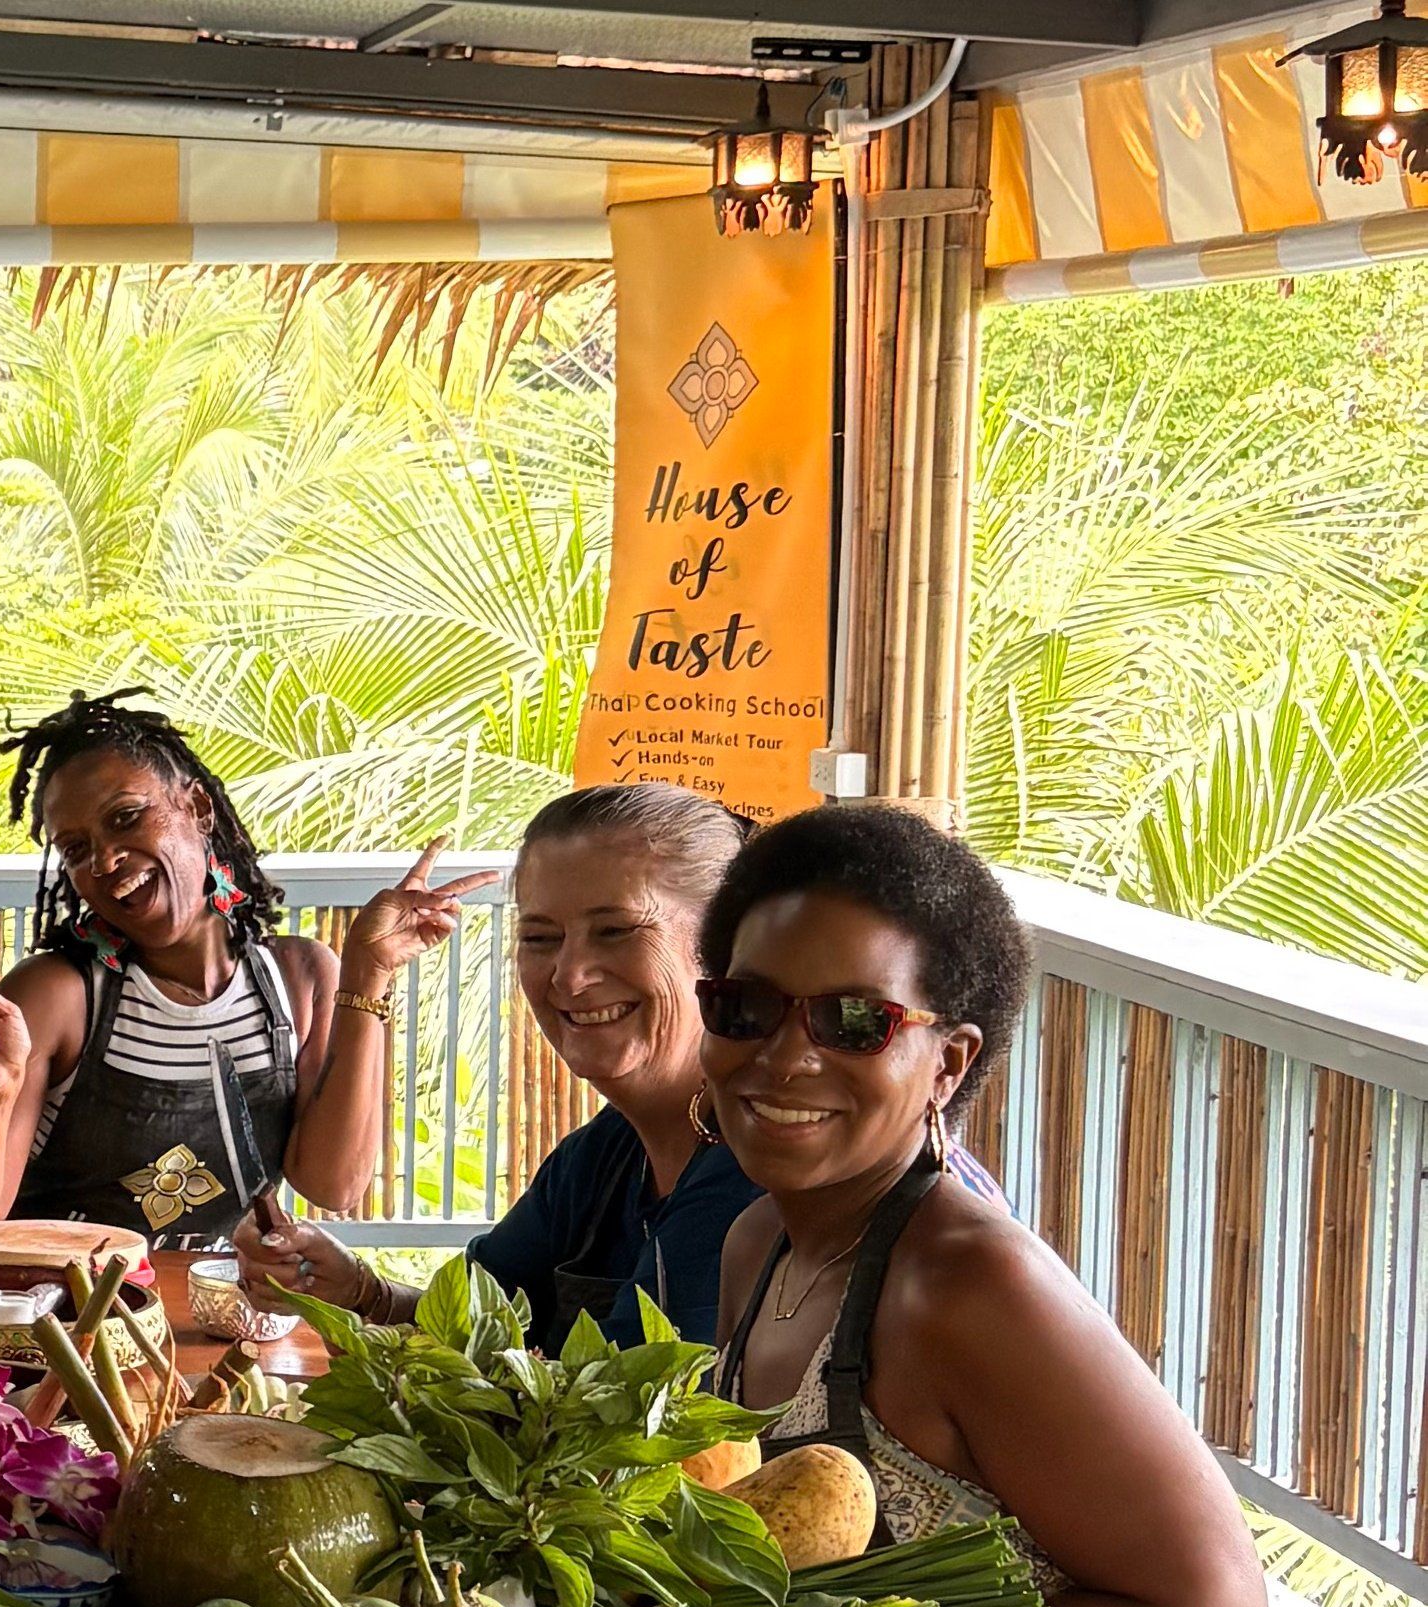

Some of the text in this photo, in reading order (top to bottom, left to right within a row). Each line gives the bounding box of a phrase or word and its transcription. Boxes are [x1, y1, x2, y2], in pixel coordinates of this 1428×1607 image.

[644, 461, 793, 530] House
[669, 537, 728, 600] of
[628, 608, 773, 678] Taste
[590, 693, 824, 719] Thai Cooking School
[636, 729, 784, 750] Local Market Tour
[638, 751, 715, 767] Hands-on
[692, 776, 726, 795] Easy
